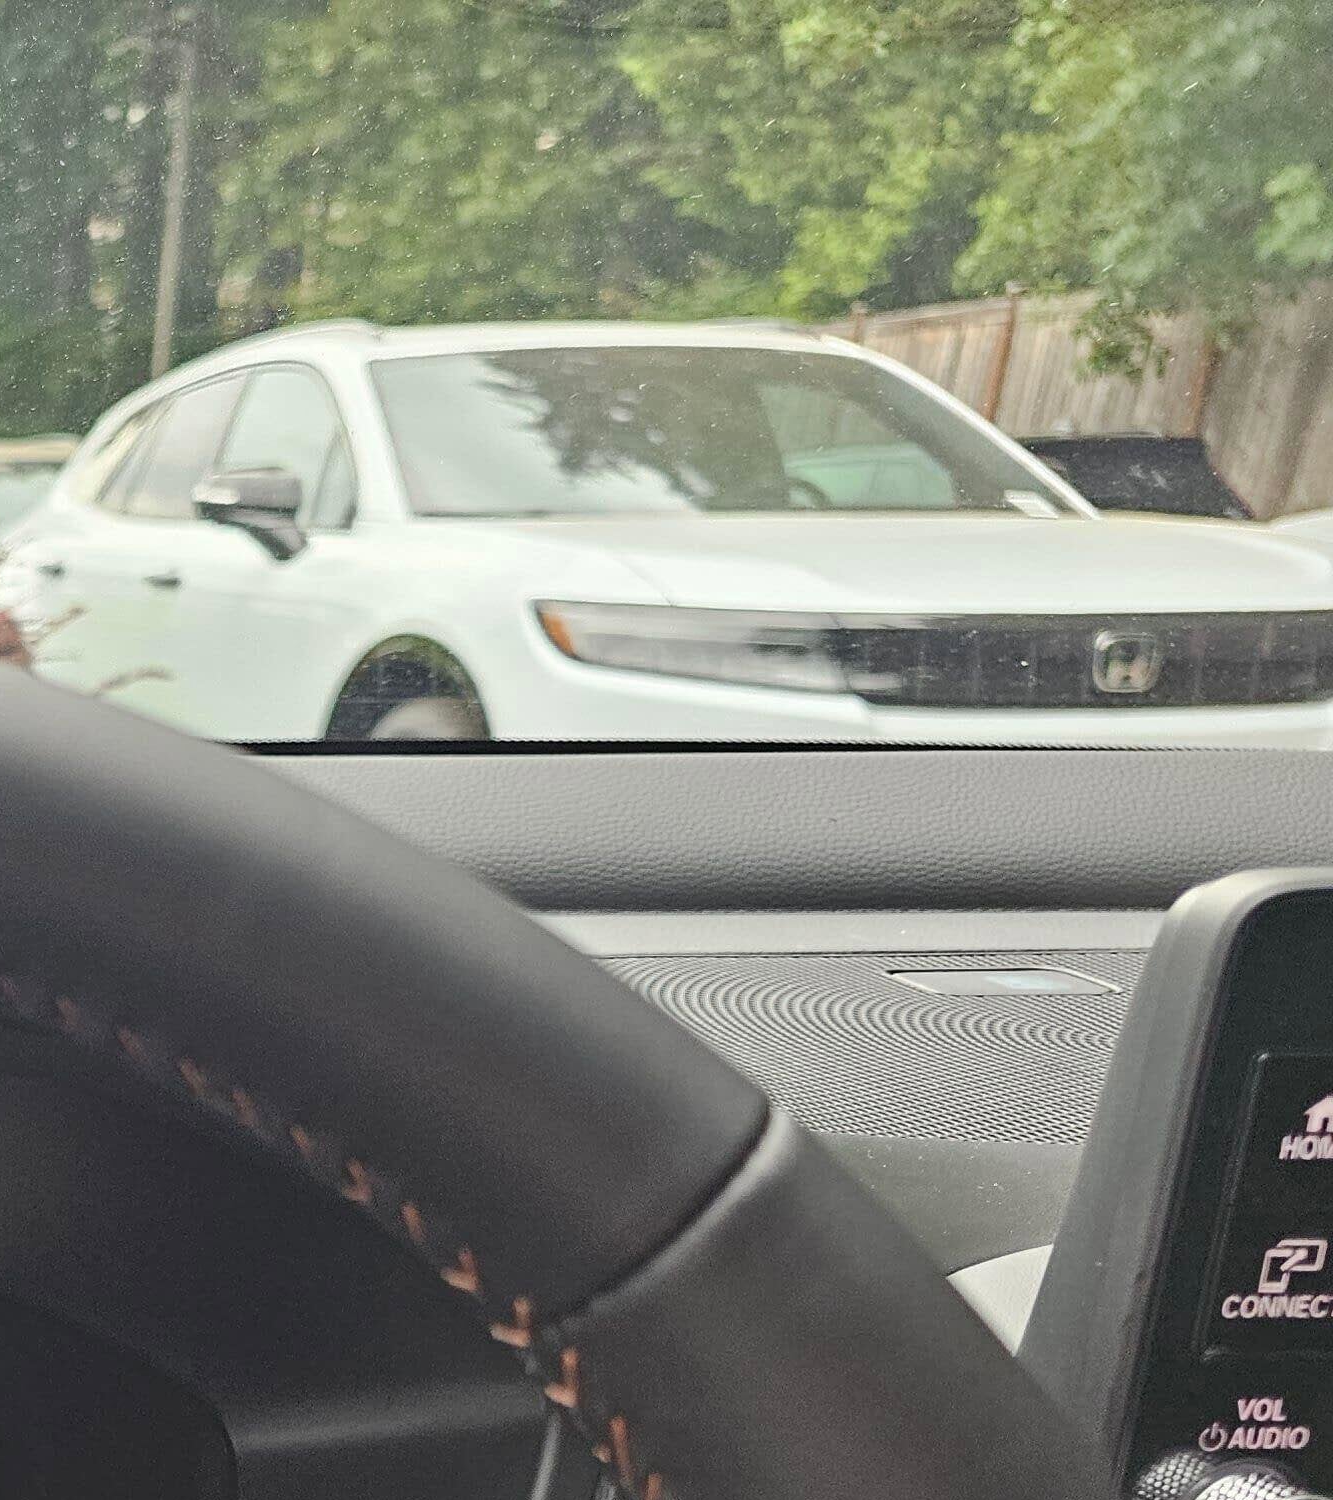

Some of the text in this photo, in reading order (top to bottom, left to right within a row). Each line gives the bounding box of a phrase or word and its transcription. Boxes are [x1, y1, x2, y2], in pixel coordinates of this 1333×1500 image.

[1221, 1294, 1333, 1319] CONNEC
[1236, 1397, 1287, 1422] VOL
[1227, 1426, 1311, 1450] AUDIO
